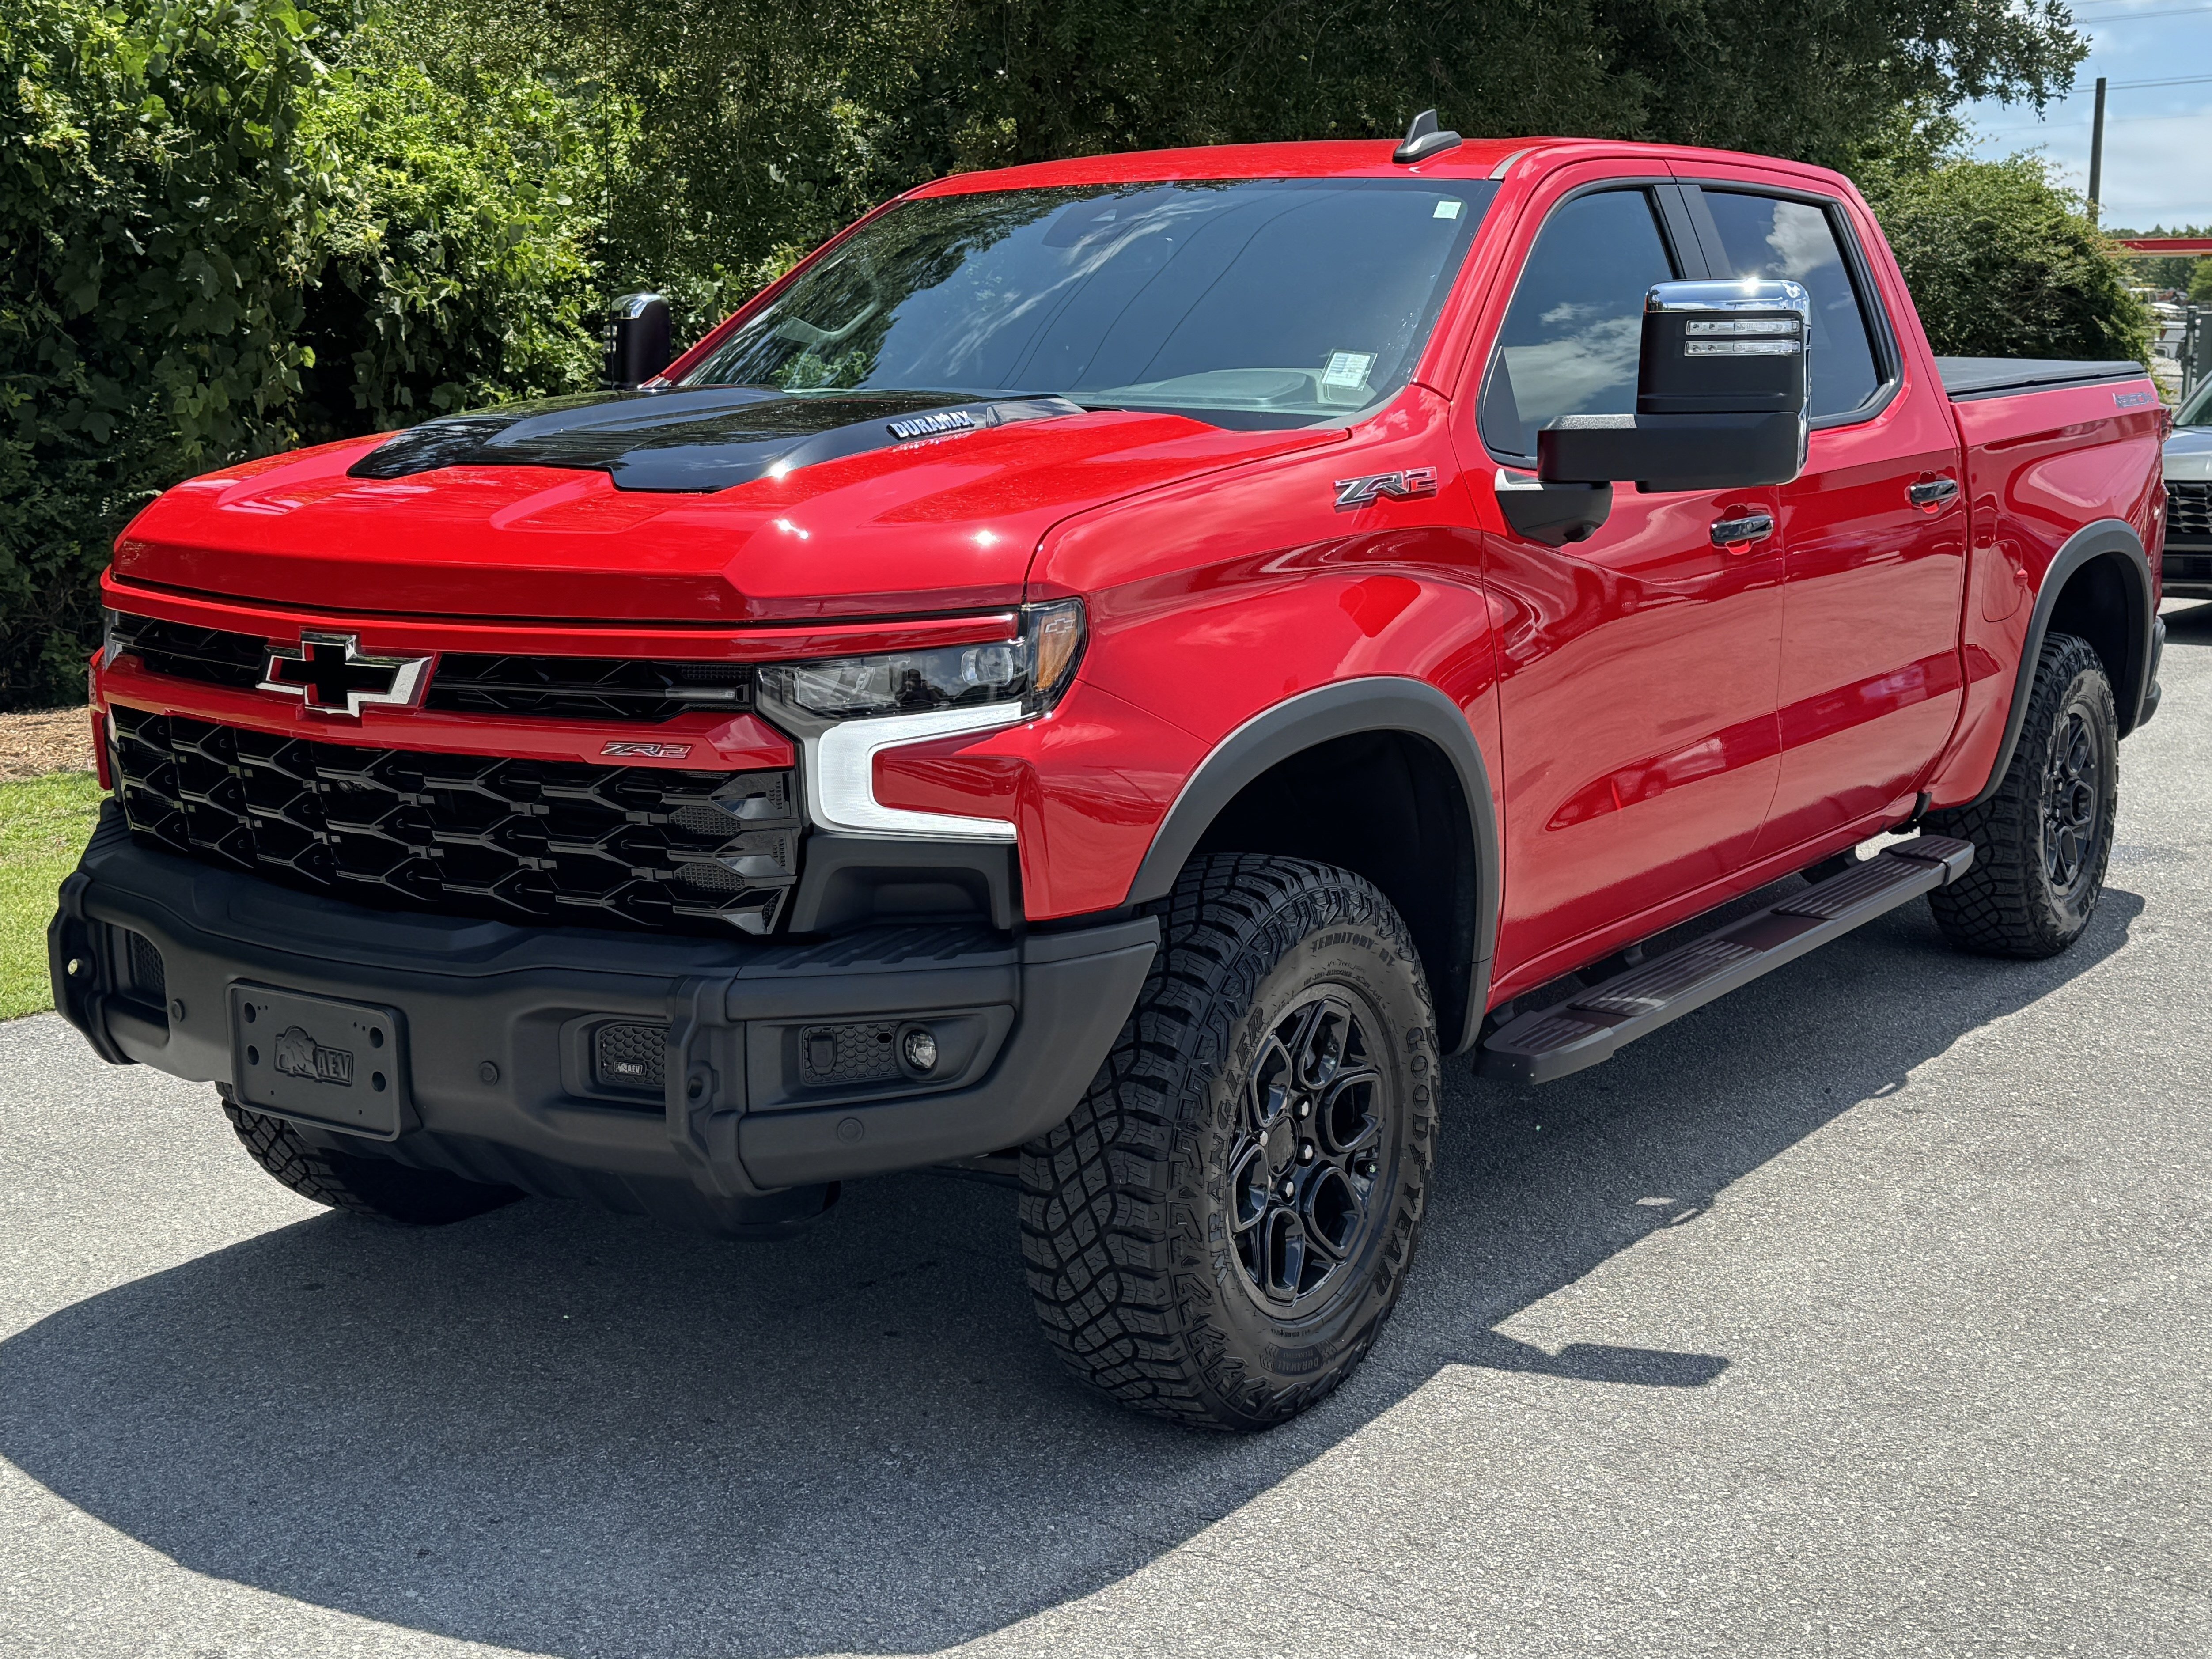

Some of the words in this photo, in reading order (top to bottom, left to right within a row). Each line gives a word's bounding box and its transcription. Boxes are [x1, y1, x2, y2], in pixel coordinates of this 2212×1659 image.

[891, 411, 976, 437] DURAMAX
[1333, 467, 1437, 507] ZR2
[600, 742, 692, 758] ZR2
[1312, 932, 1375, 952] TERRITORY
[317, 1051, 351, 1080] AEV
[628, 1064, 640, 1073] AEV
[1373, 1027, 1430, 1296] GOODYEAR
